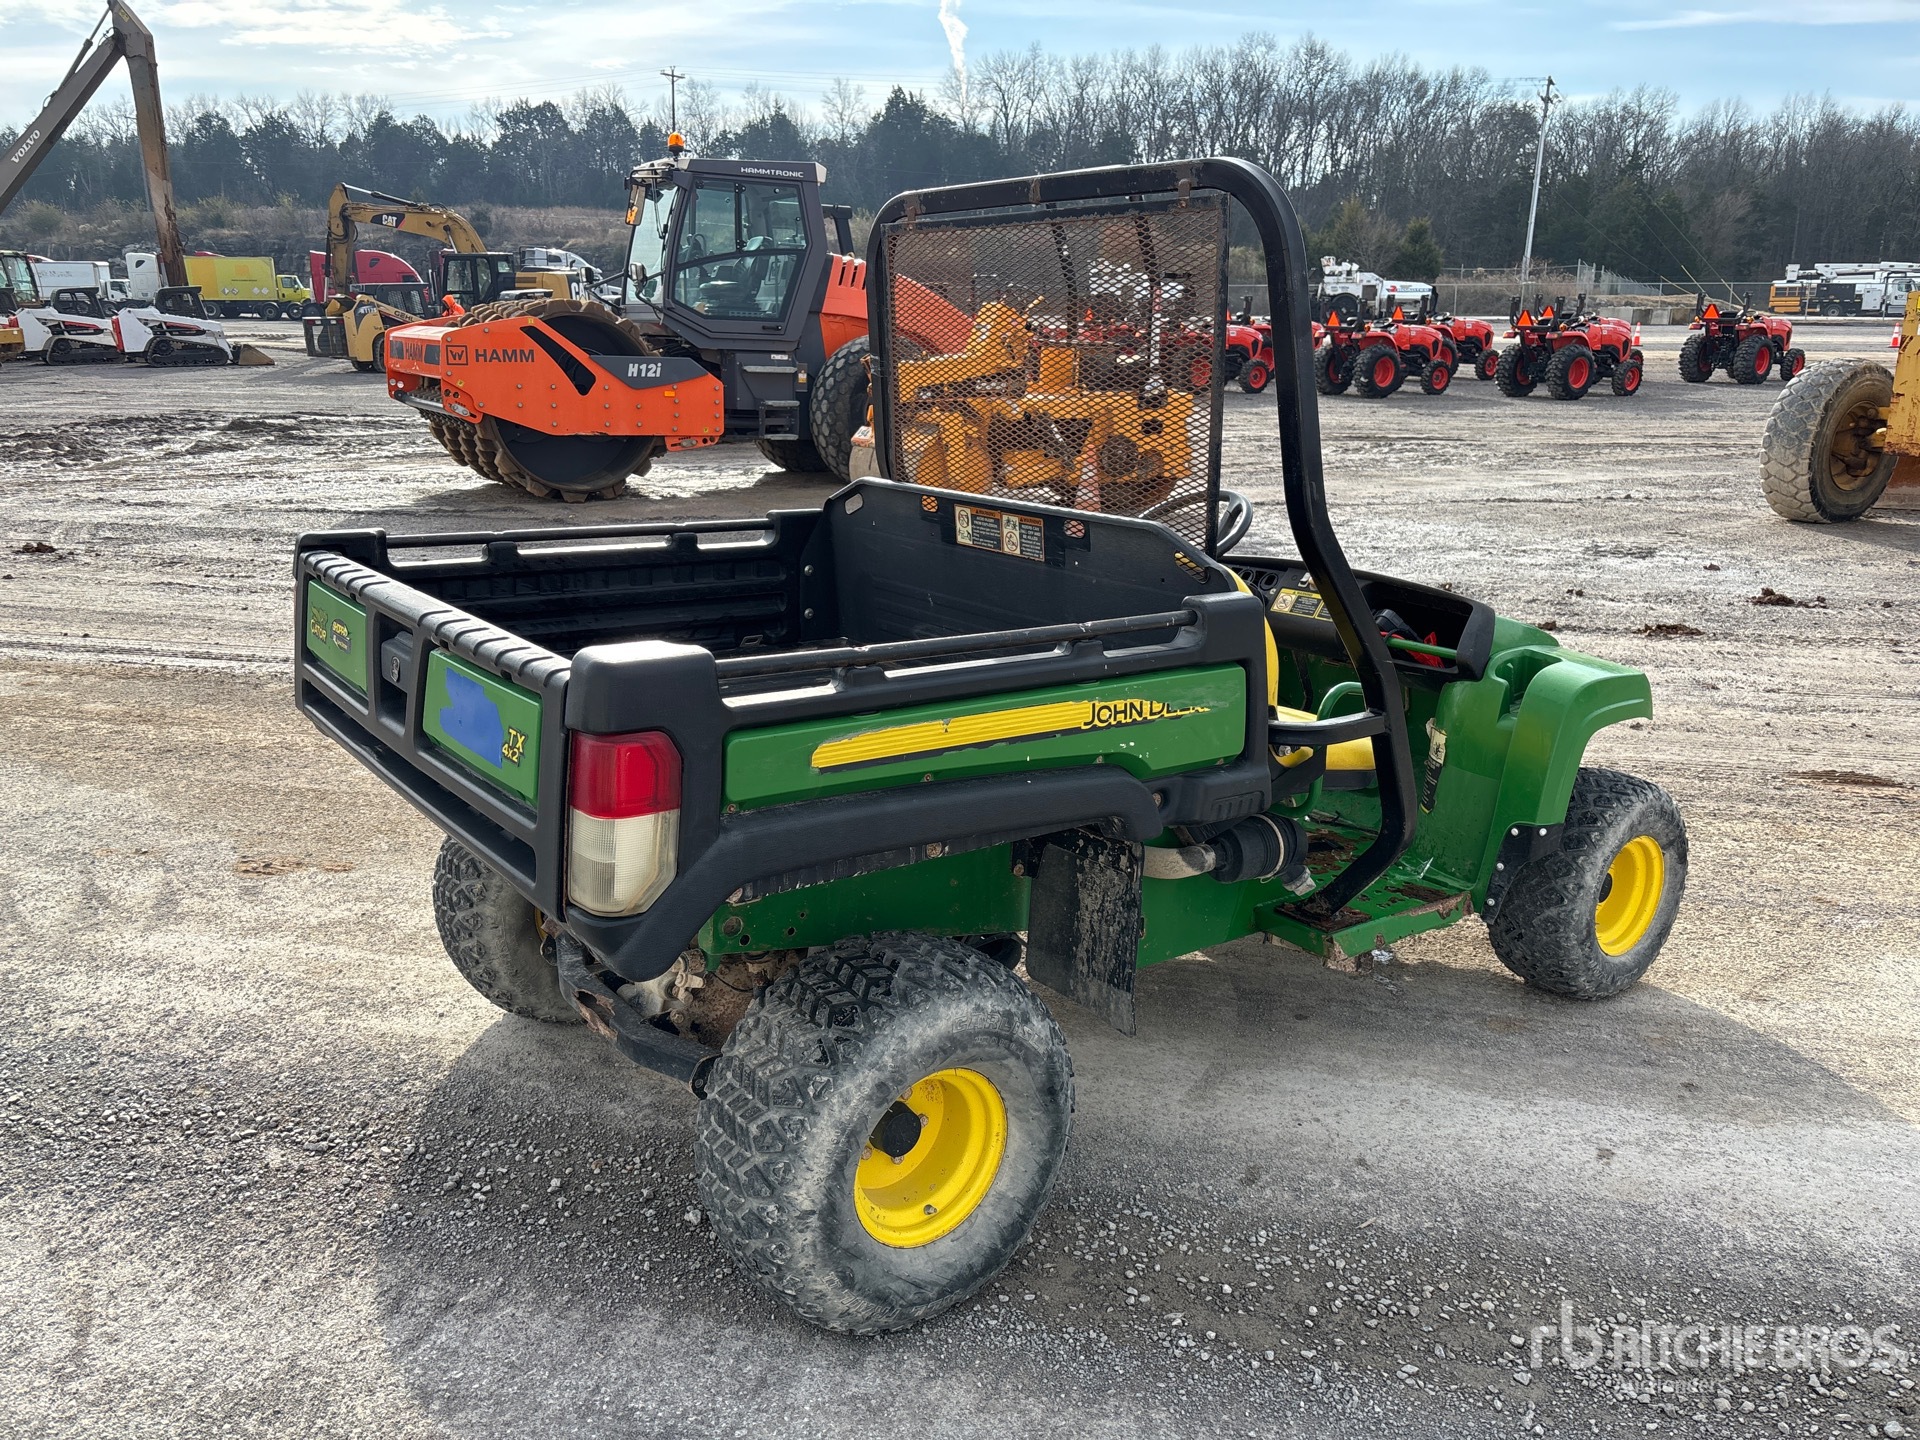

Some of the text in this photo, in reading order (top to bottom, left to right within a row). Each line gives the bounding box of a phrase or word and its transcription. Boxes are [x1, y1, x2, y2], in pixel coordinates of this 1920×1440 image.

[11, 130, 40, 163] VOLVO
[741, 167, 804, 178] HAMMTRONIC
[382, 214, 397, 227] CAT
[394, 310, 414, 322] GEHL
[475, 349, 535, 363] HAMM
[628, 363, 662, 377] H12i
[1083, 700, 1143, 726] JOHN
[509, 728, 525, 753] TX
[502, 743, 519, 763] 4x2
